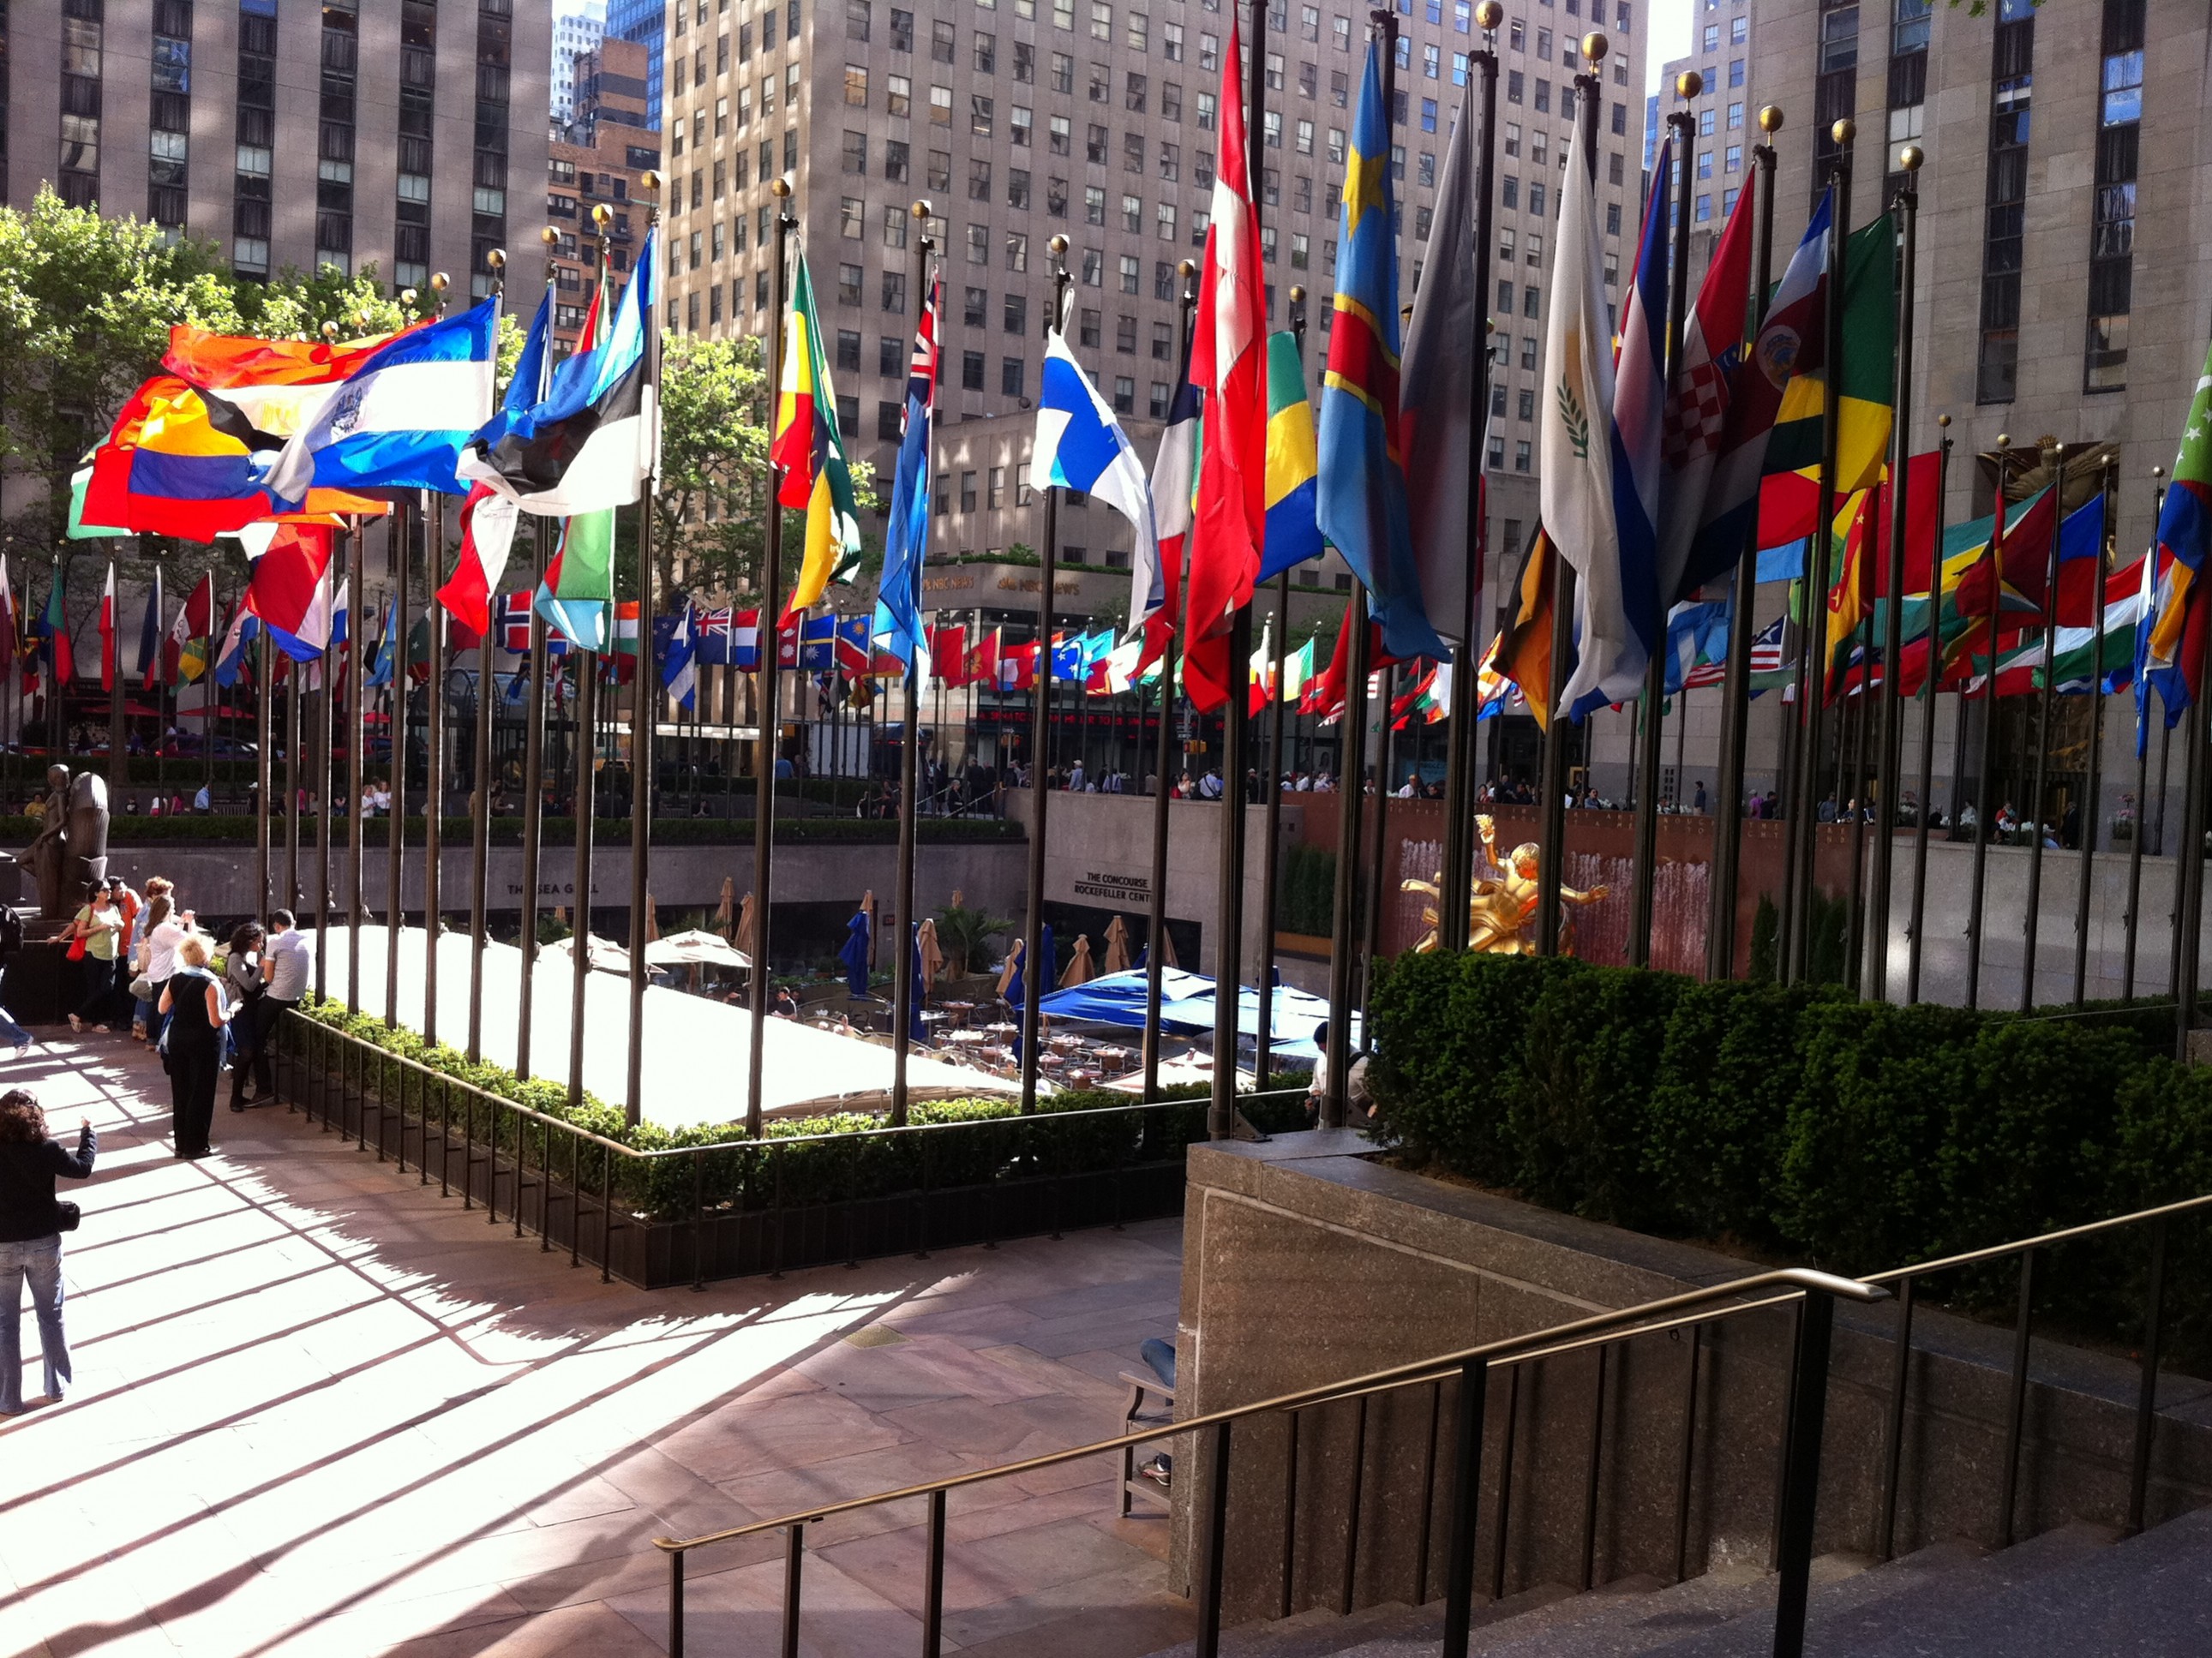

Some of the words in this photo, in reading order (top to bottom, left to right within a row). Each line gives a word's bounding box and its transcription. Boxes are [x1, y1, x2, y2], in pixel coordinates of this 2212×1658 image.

[1087, 872, 1100, 883] THE
[1102, 875, 1148, 889] CONCOURSE
[537, 884, 560, 895] SEA
[1074, 884, 1126, 900] ROCKEFELLER
[1128, 892, 1151, 903] CENT
